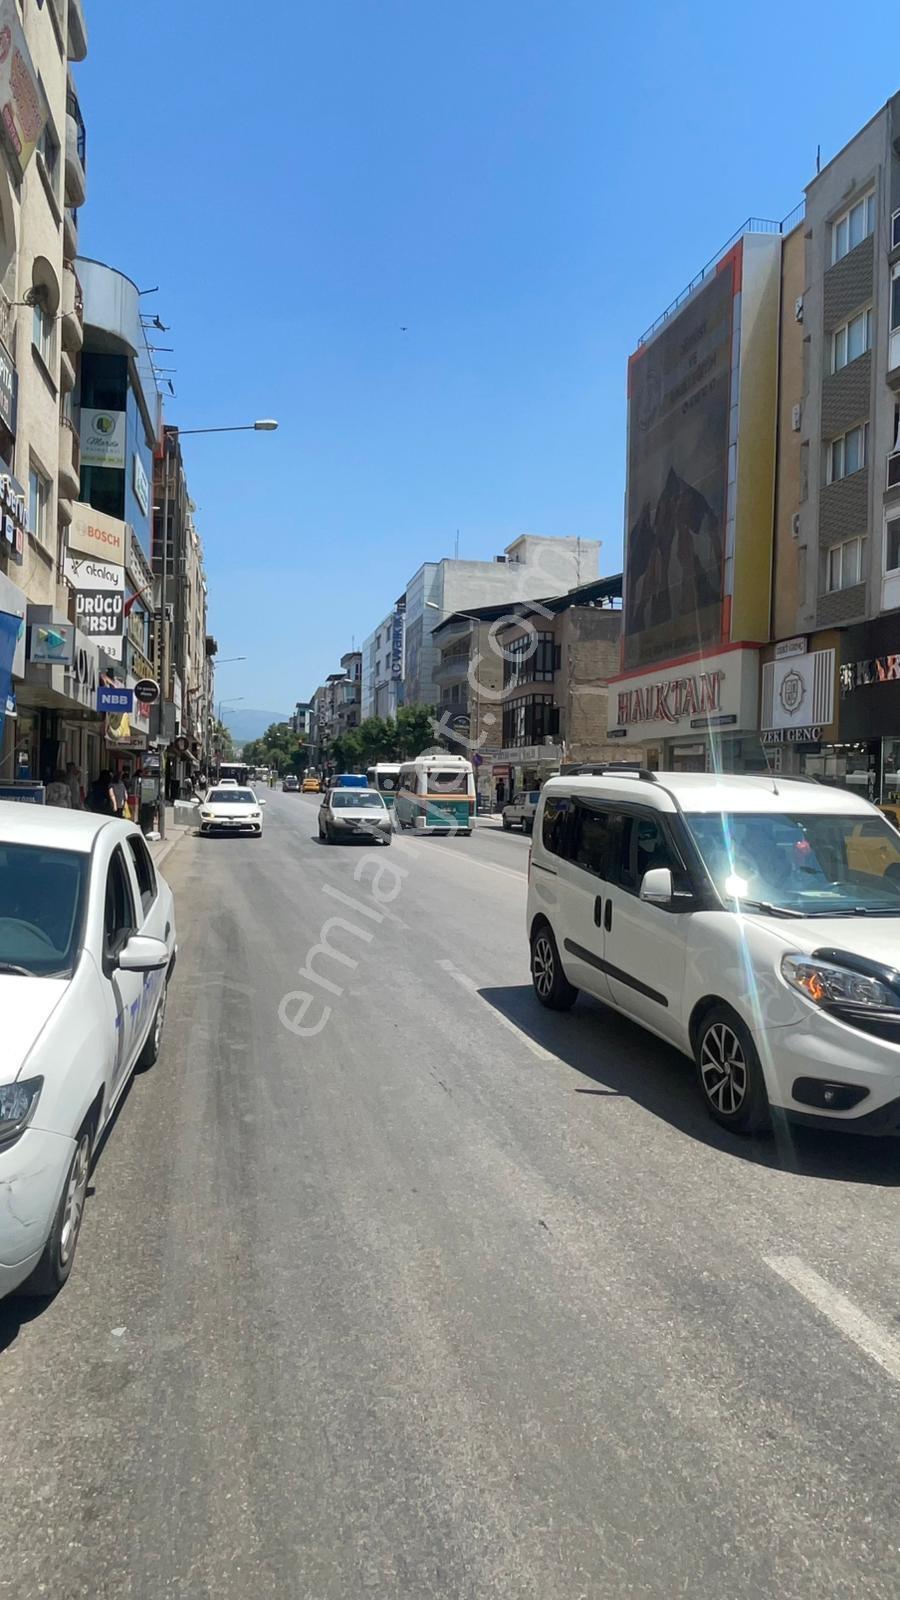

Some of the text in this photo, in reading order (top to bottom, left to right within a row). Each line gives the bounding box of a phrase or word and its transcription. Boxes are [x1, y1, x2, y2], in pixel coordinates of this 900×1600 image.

[87, 526, 120, 547] BOSCH
[86, 564, 119, 585] atalay
[87, 615, 117, 632] RSU
[102, 694, 128, 705] NBB
[618, 671, 723, 724] HALKTAN
[763, 727, 822, 743] ZEKİ GENÇ
